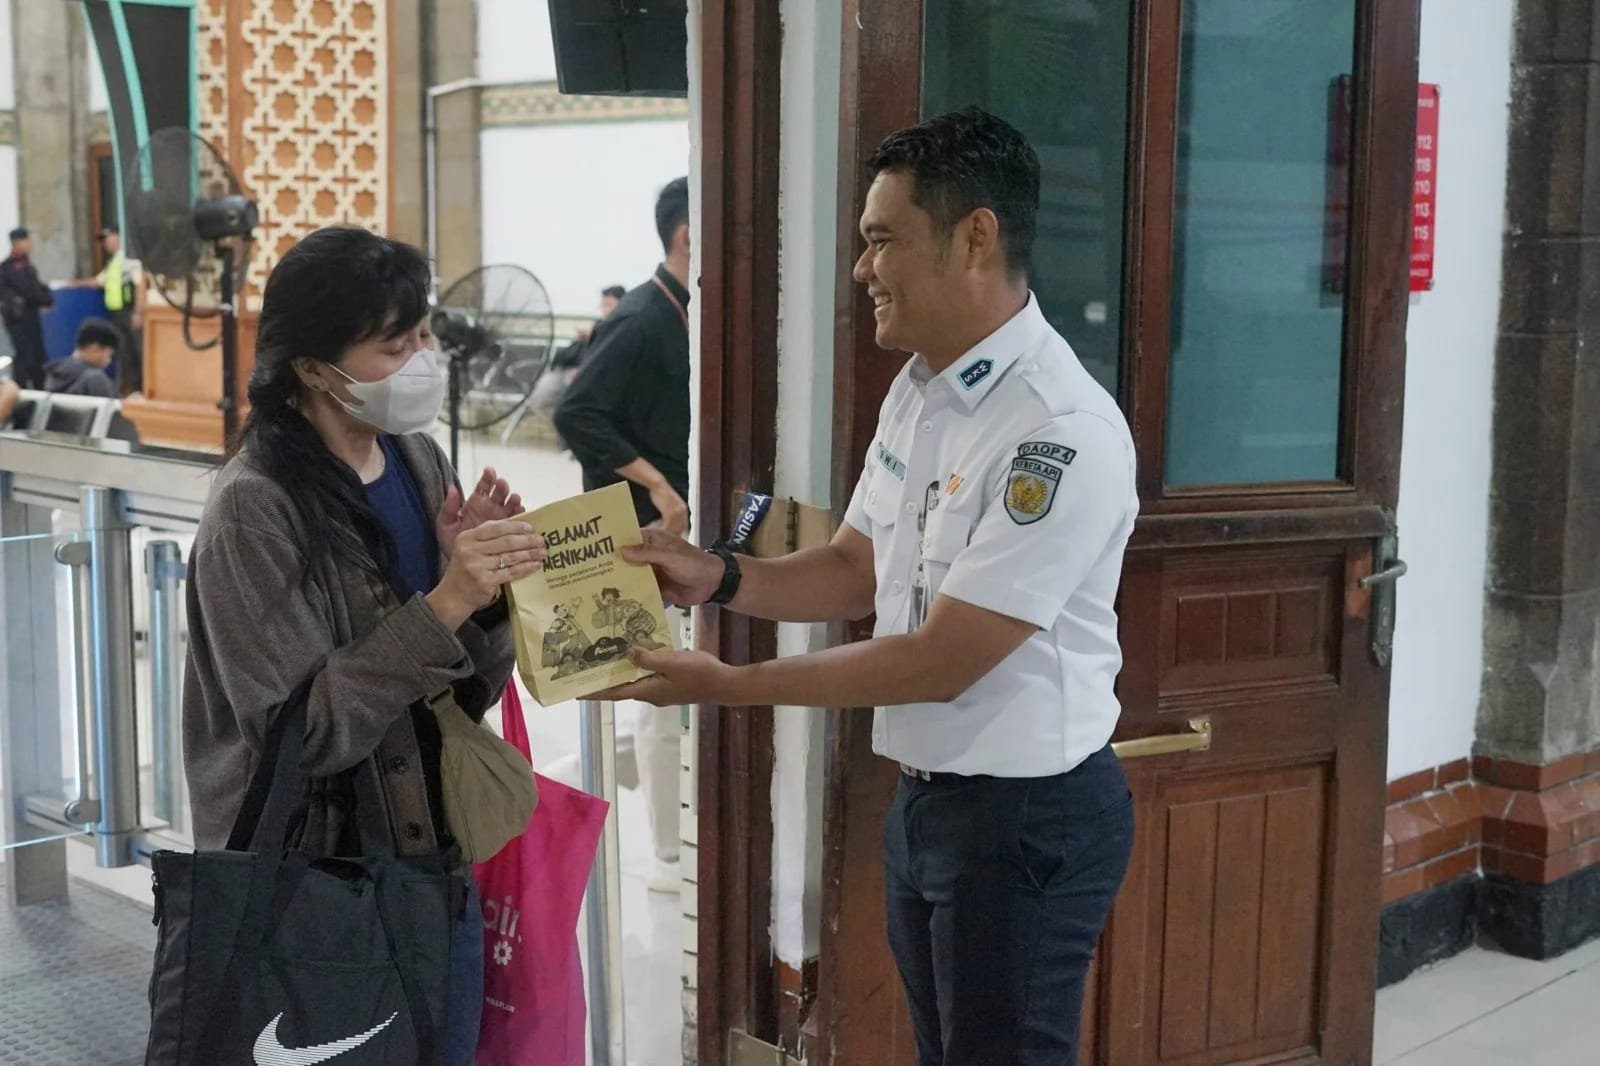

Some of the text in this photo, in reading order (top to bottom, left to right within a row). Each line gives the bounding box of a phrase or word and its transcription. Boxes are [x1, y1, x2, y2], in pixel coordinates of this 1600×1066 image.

[1022, 444, 1070, 461] DAOP 4
[1015, 460, 1059, 479] KERETA API
[542, 535, 615, 573] MENIKMATI
